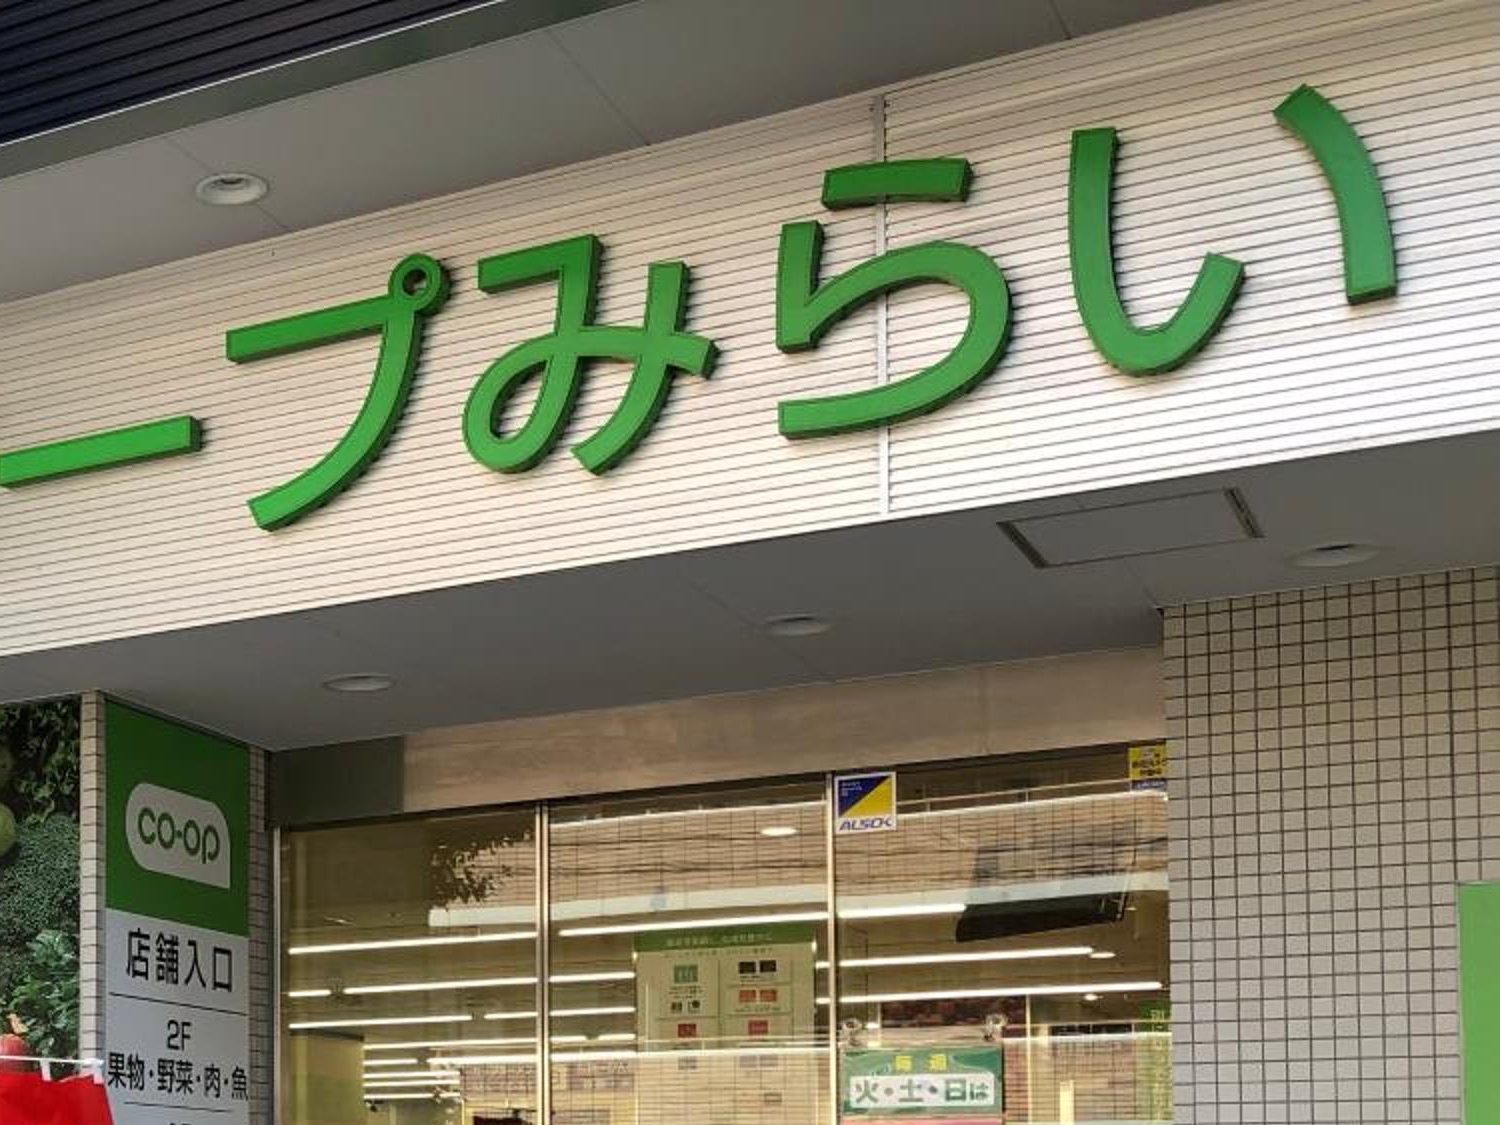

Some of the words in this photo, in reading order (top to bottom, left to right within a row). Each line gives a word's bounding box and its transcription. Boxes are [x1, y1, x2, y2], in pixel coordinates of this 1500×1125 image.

[125, 926, 234, 992] 店舗入口
[166, 1019, 192, 1051] 2F
[107, 1051, 248, 1100] 果物・野菜・肉・魚
[855, 1078, 990, 1104] 火・土・日は
